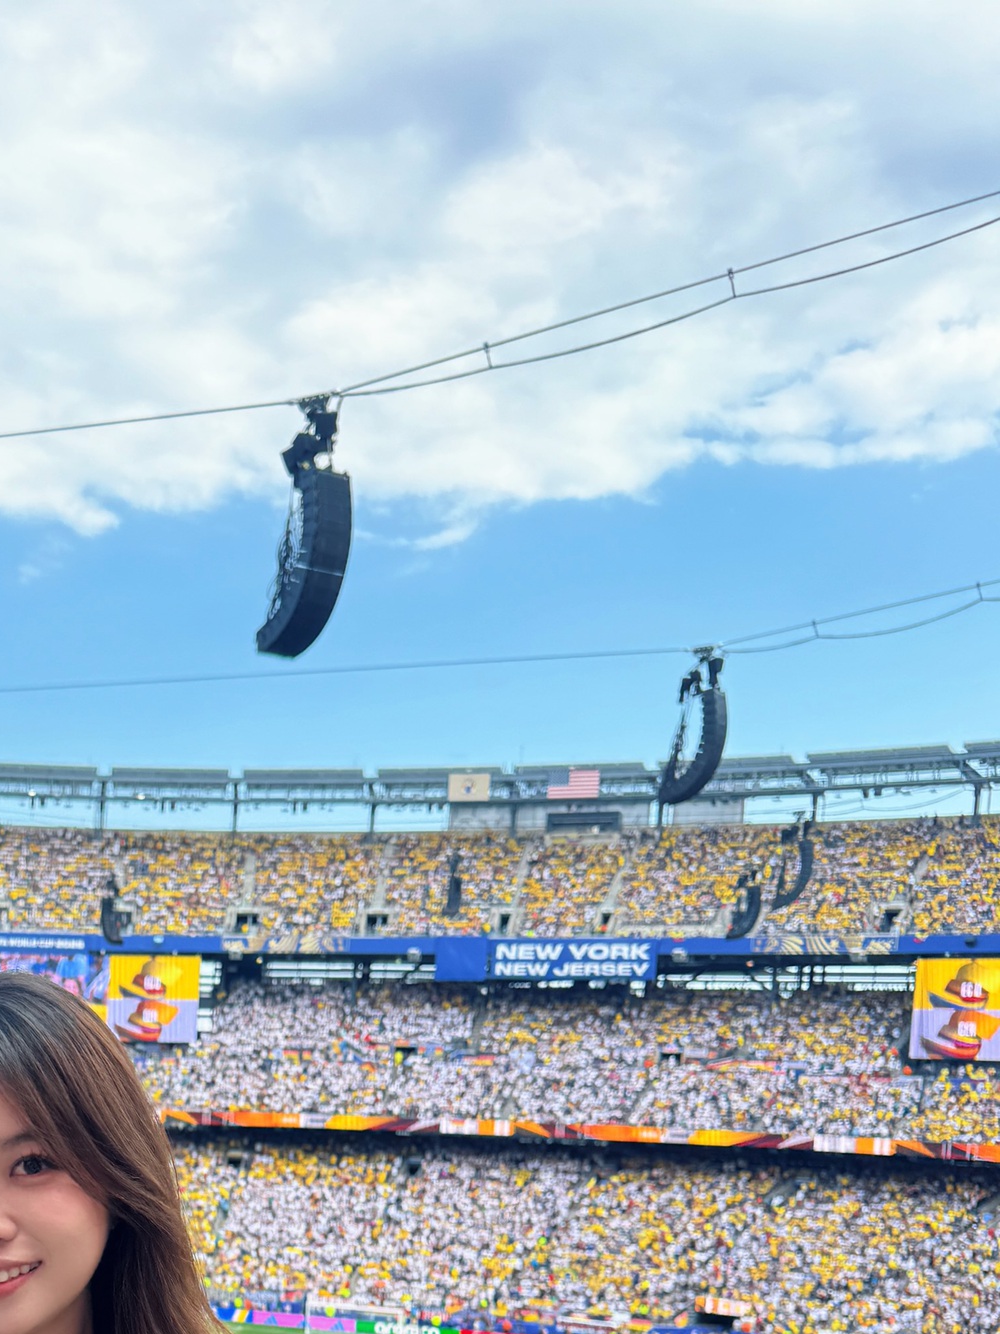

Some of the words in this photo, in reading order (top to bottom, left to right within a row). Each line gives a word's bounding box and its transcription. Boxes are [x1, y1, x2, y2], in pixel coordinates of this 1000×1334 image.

[495, 943, 564, 960] NEW
[568, 943, 651, 960] YORK
[494, 962, 551, 976] NEW
[552, 962, 651, 977] JERSEY
